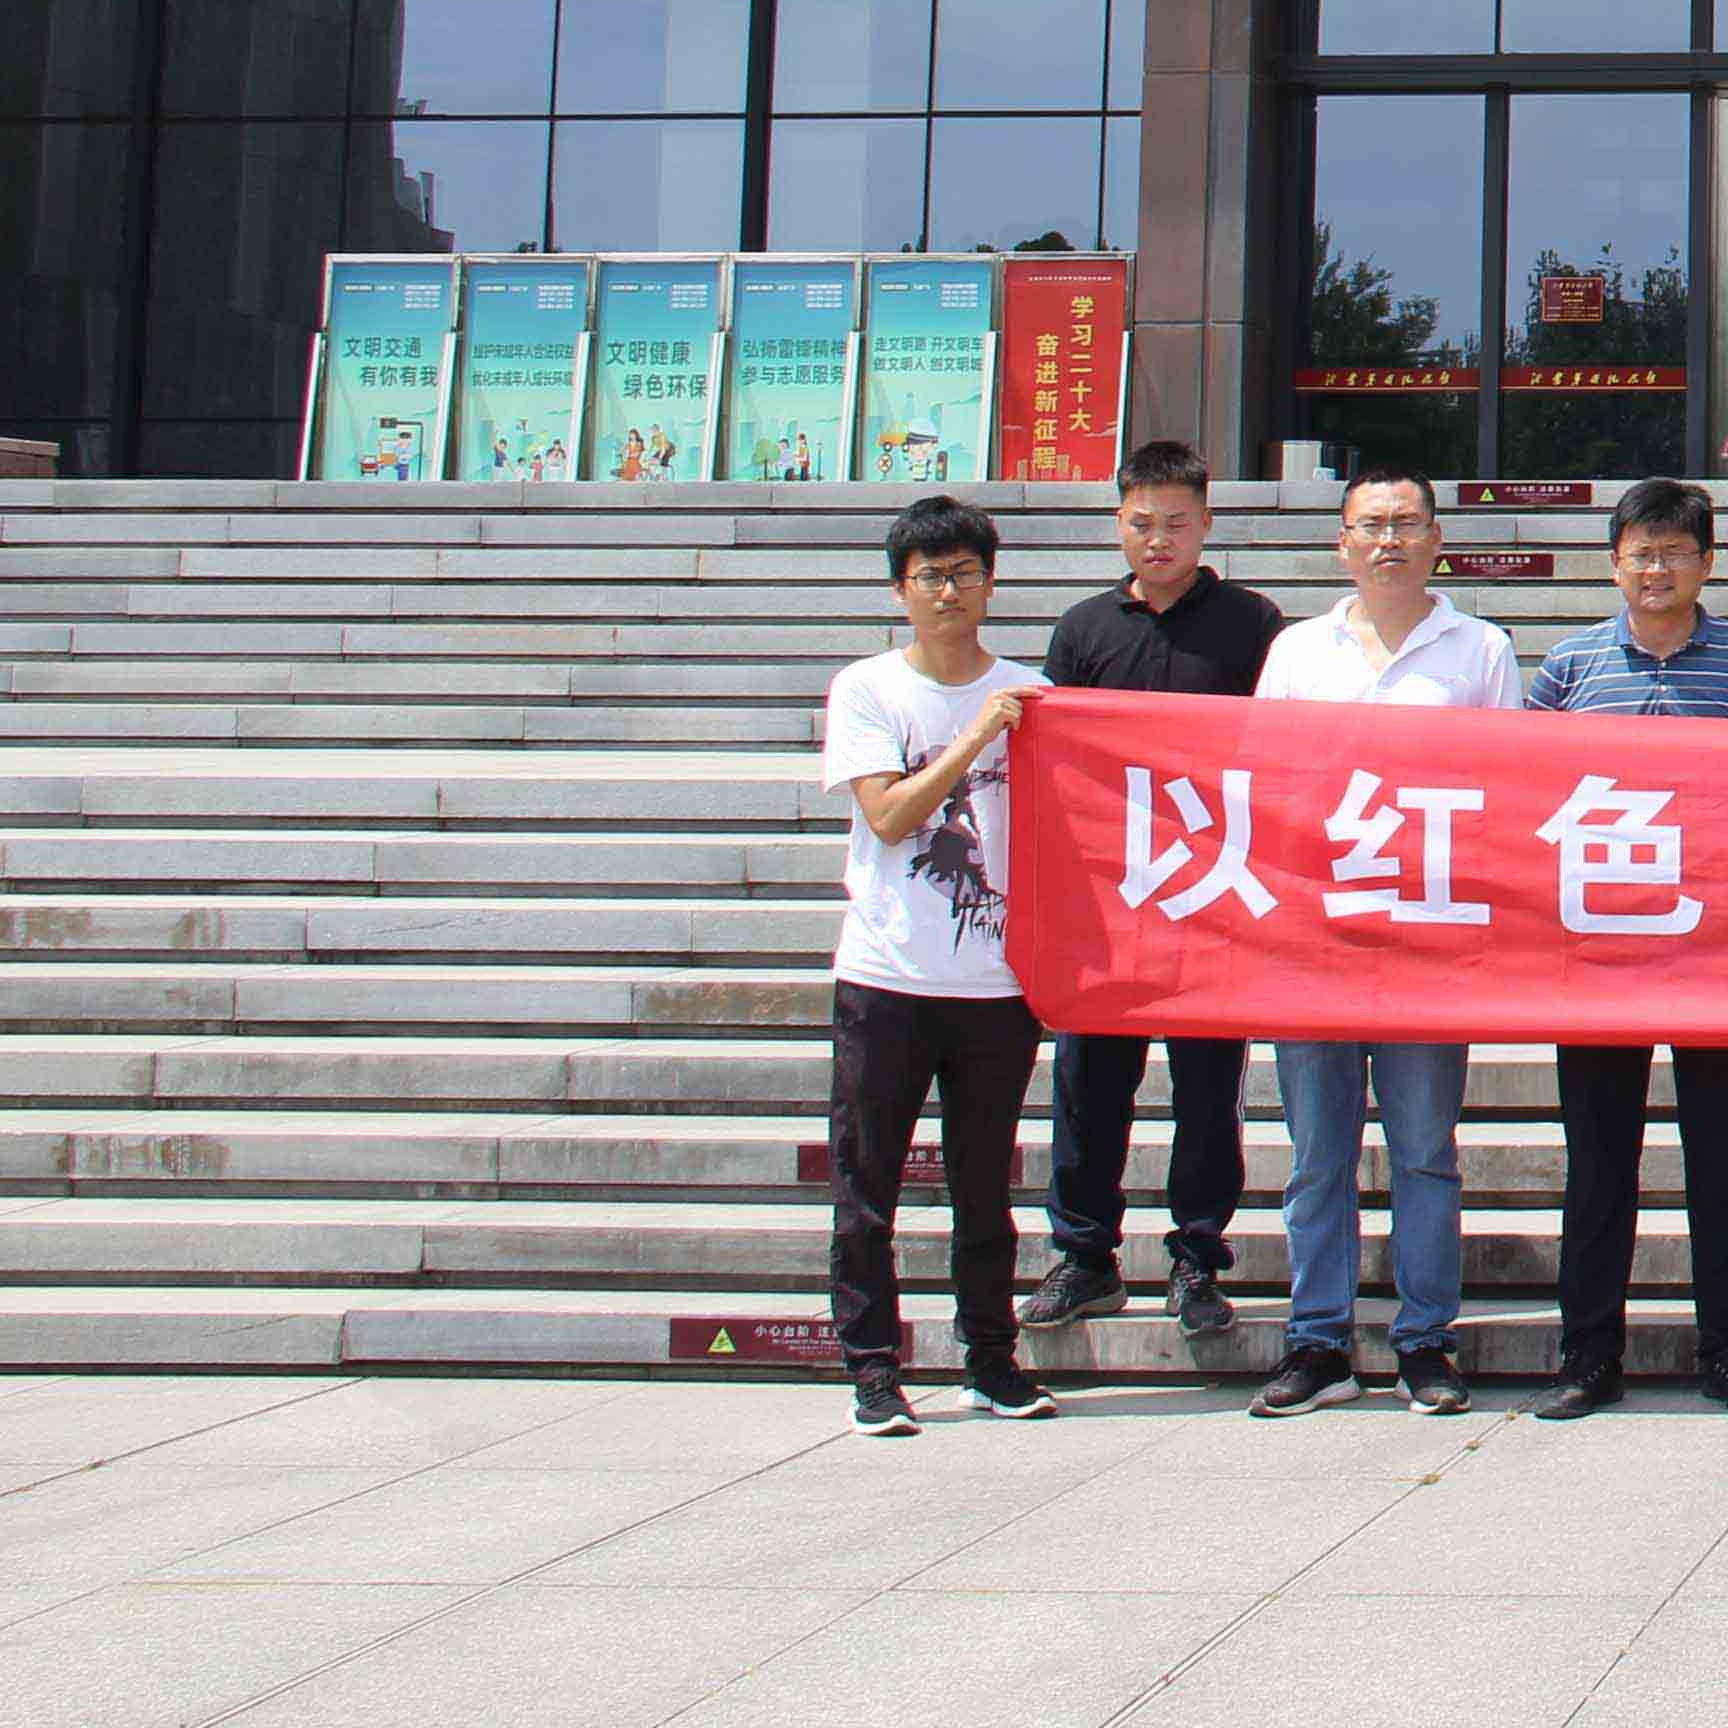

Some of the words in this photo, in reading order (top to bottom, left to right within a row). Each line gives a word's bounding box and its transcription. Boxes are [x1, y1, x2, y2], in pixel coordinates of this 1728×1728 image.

[345, 336, 423, 359] 文明交通
[606, 339, 692, 366] 文明健康
[742, 337, 847, 360] 弘扬雷锋精神
[930, 335, 983, 352] 开文明车
[1068, 295, 1095, 431] 学习二十大
[360, 365, 439, 387] 有你有我
[624, 373, 709, 400] 绿色环保
[742, 364, 846, 387] 参与志愿服务
[1032, 332, 1060, 469] 奋进新征程
